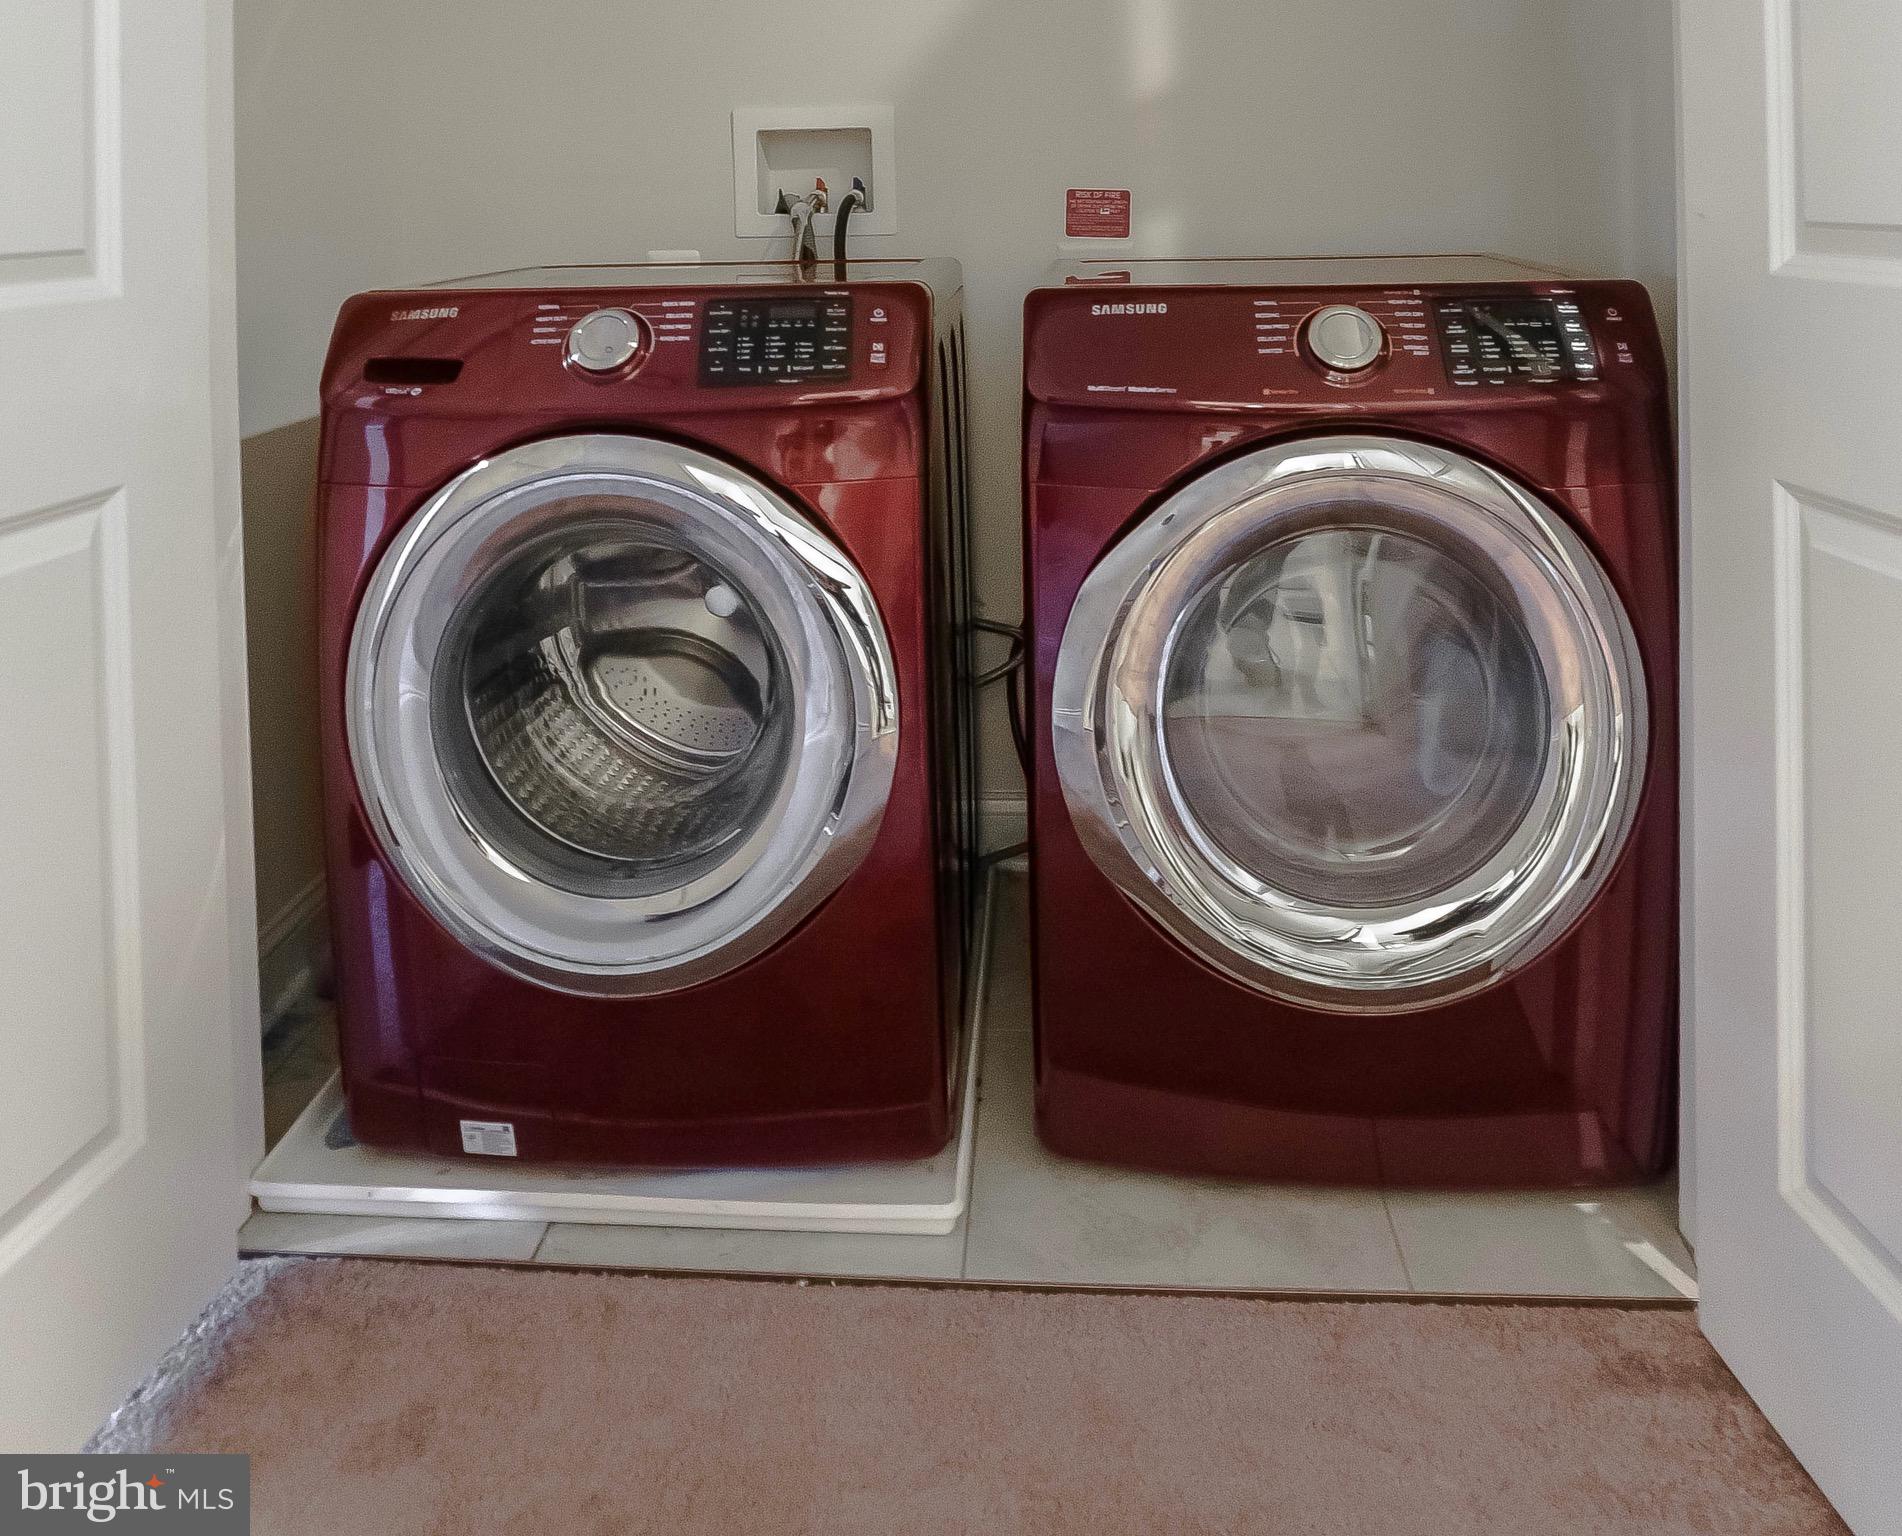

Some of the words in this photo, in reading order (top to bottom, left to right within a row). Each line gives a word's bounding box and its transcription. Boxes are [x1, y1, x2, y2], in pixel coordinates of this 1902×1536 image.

[1093, 191, 1104, 199] OF
[1104, 191, 1121, 200] FIRE
[391, 307, 459, 321] SAMSUNG
[1091, 303, 1168, 316] SAMSUNG
